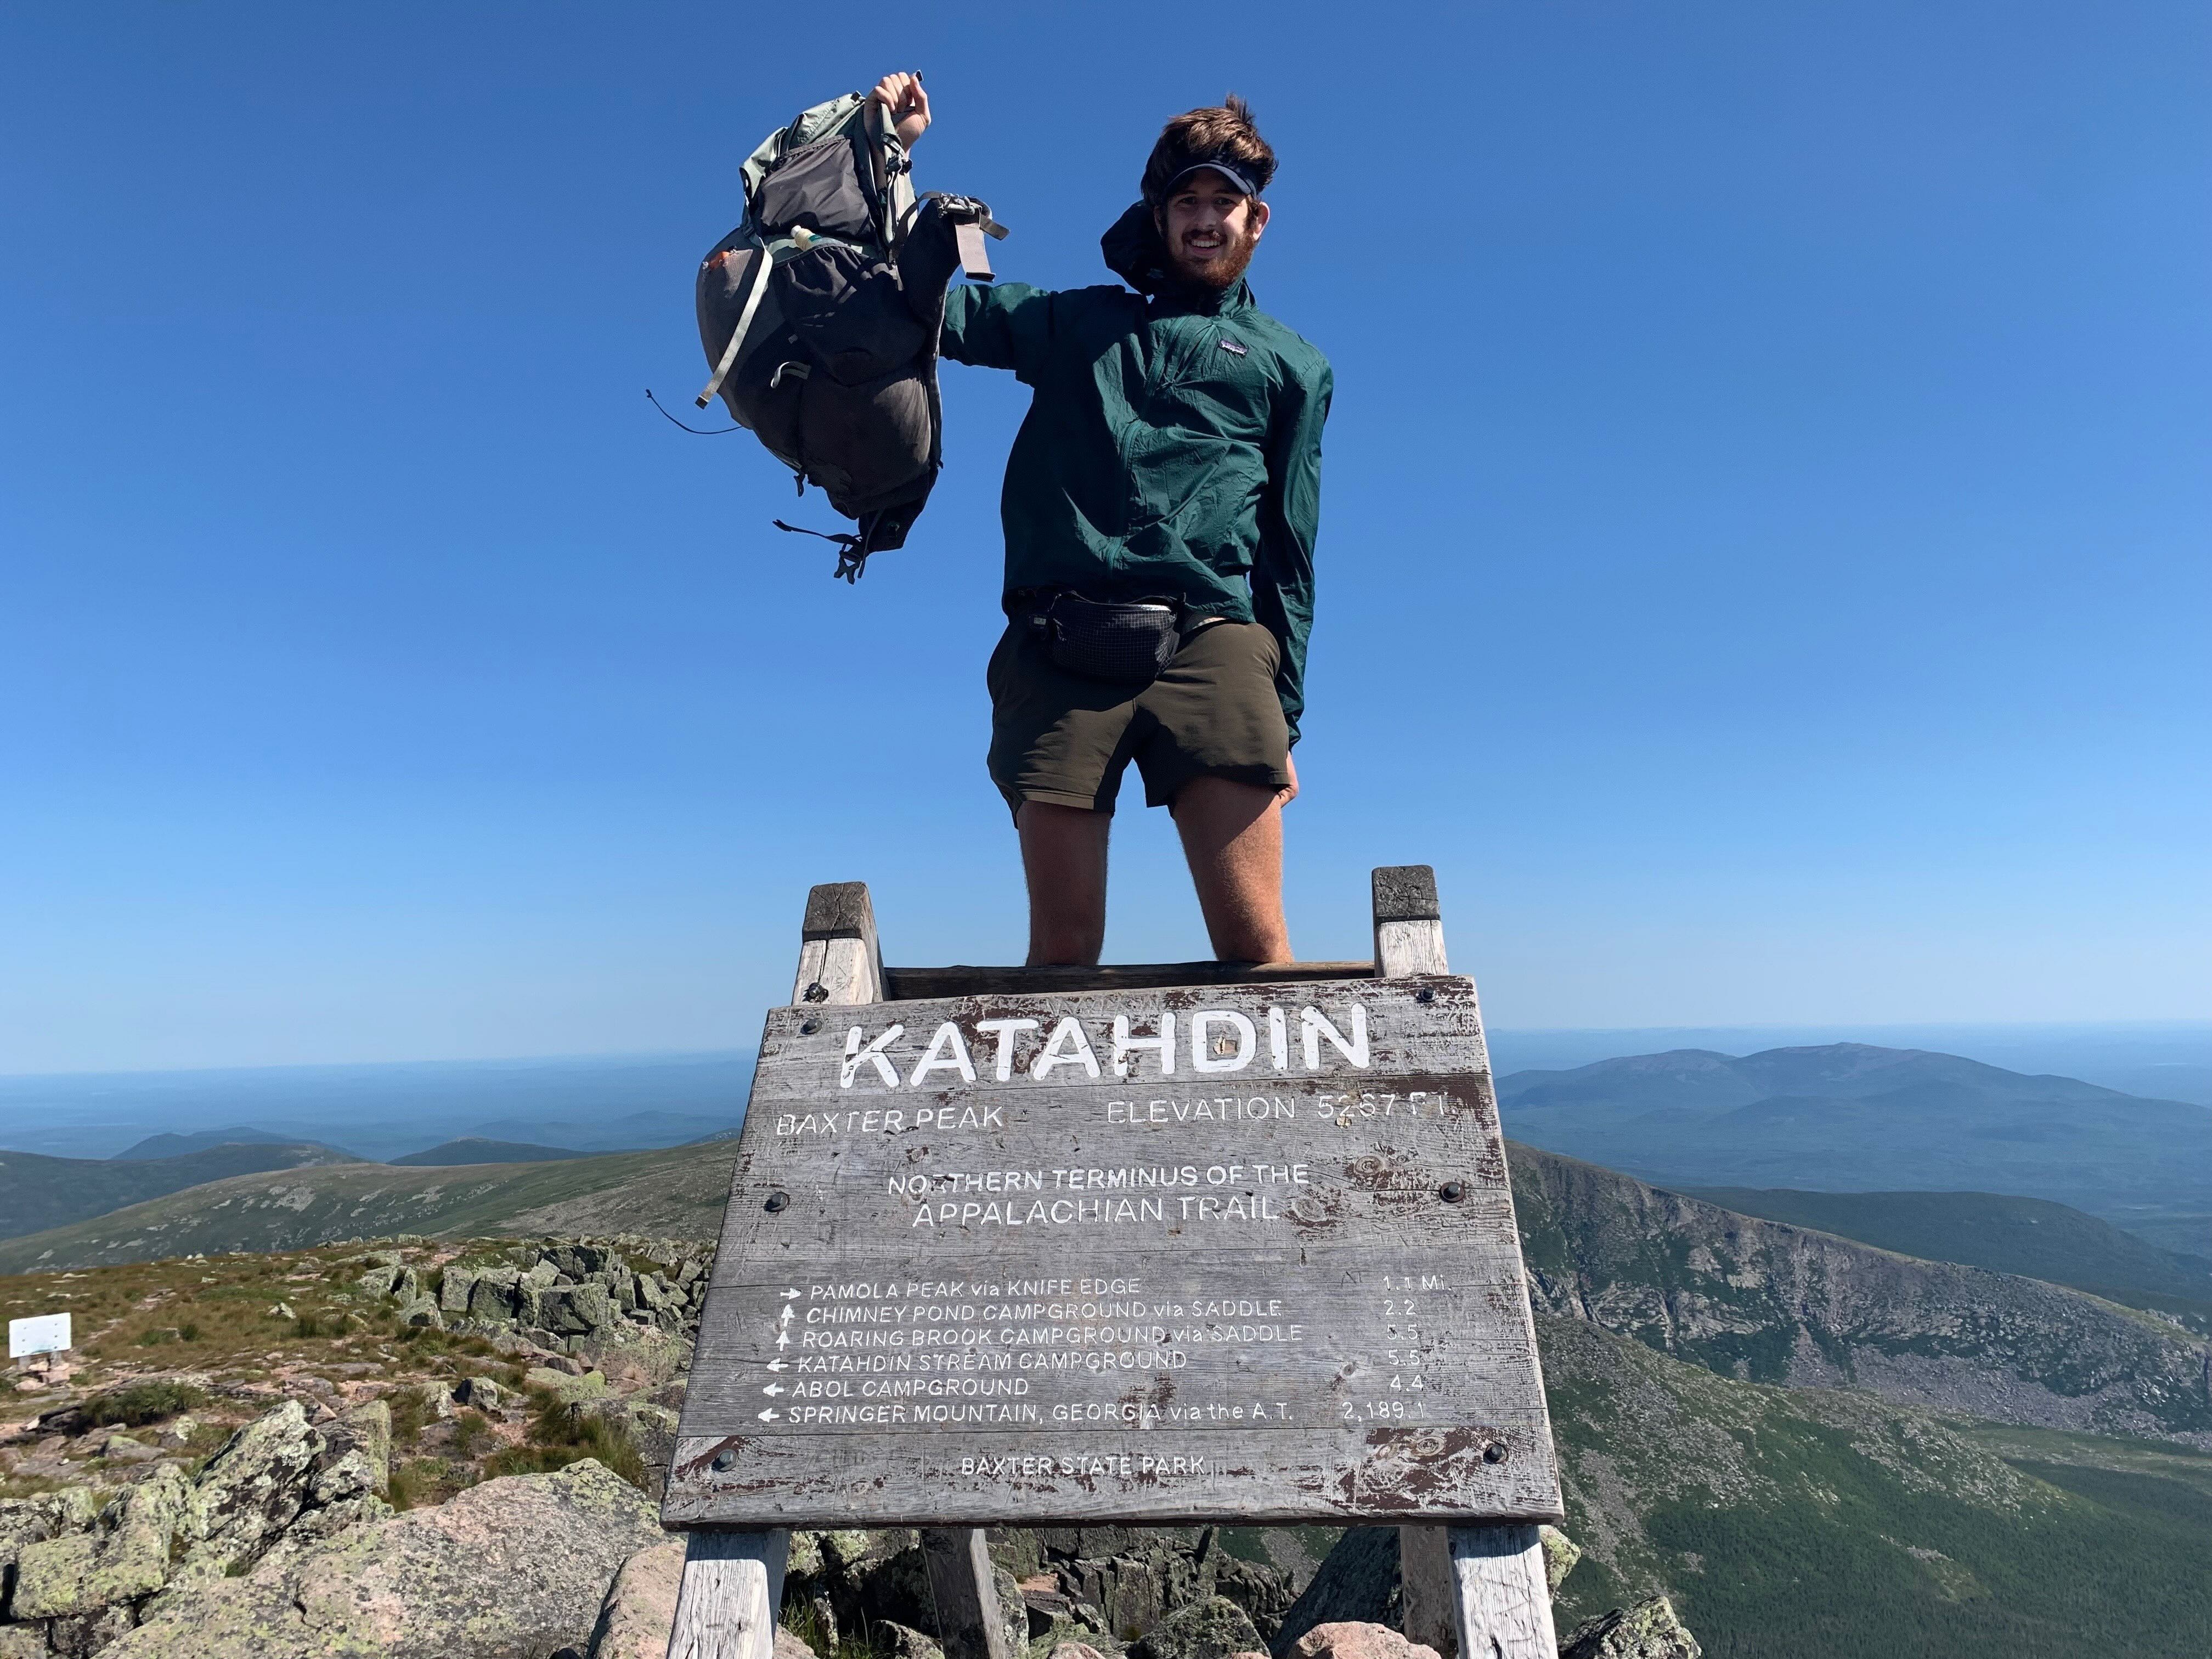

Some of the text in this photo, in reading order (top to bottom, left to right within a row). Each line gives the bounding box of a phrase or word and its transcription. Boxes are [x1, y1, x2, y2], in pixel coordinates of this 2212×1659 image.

[839, 1002, 1371, 1088] KATAHDIN
[776, 1105, 1003, 1136] BAXTER PEAK
[1107, 1096, 1295, 1124] ELEVATION
[1052, 1166, 1199, 1190] TERMINUS
[1206, 1165, 1244, 1186] OF
[1251, 1164, 1310, 1184] THE
[912, 1195, 1279, 1227] APPALACHIAN TRAIL
[810, 1278, 1141, 1300] PAMOLA PEAK via KNIFE EDGE
[1383, 1274, 1452, 1290] 1.1 Mi.
[806, 1300, 1282, 1323] CHIMNEY POND CAMPGROUND via SADDLE
[1384, 1299, 1416, 1315] 2.2
[802, 1324, 1304, 1348] ROARING BROOK CAMPGROUND via SADDLE
[1387, 1324, 1418, 1340] 5.5
[798, 1351, 1187, 1373] KATAHDIN STREAM CAMPGROUND
[1388, 1349, 1420, 1365] 5.5
[792, 1378, 1028, 1398] ABOL CAMPGROUND
[1390, 1374, 1424, 1392] 4.4
[789, 1402, 1293, 1424] SPRINGER MOUNTAIN, GEORGIA via the A.T.
[1342, 1401, 1424, 1422] 2,189.1
[961, 1455, 1206, 1475] BAXTER STATE PARK
